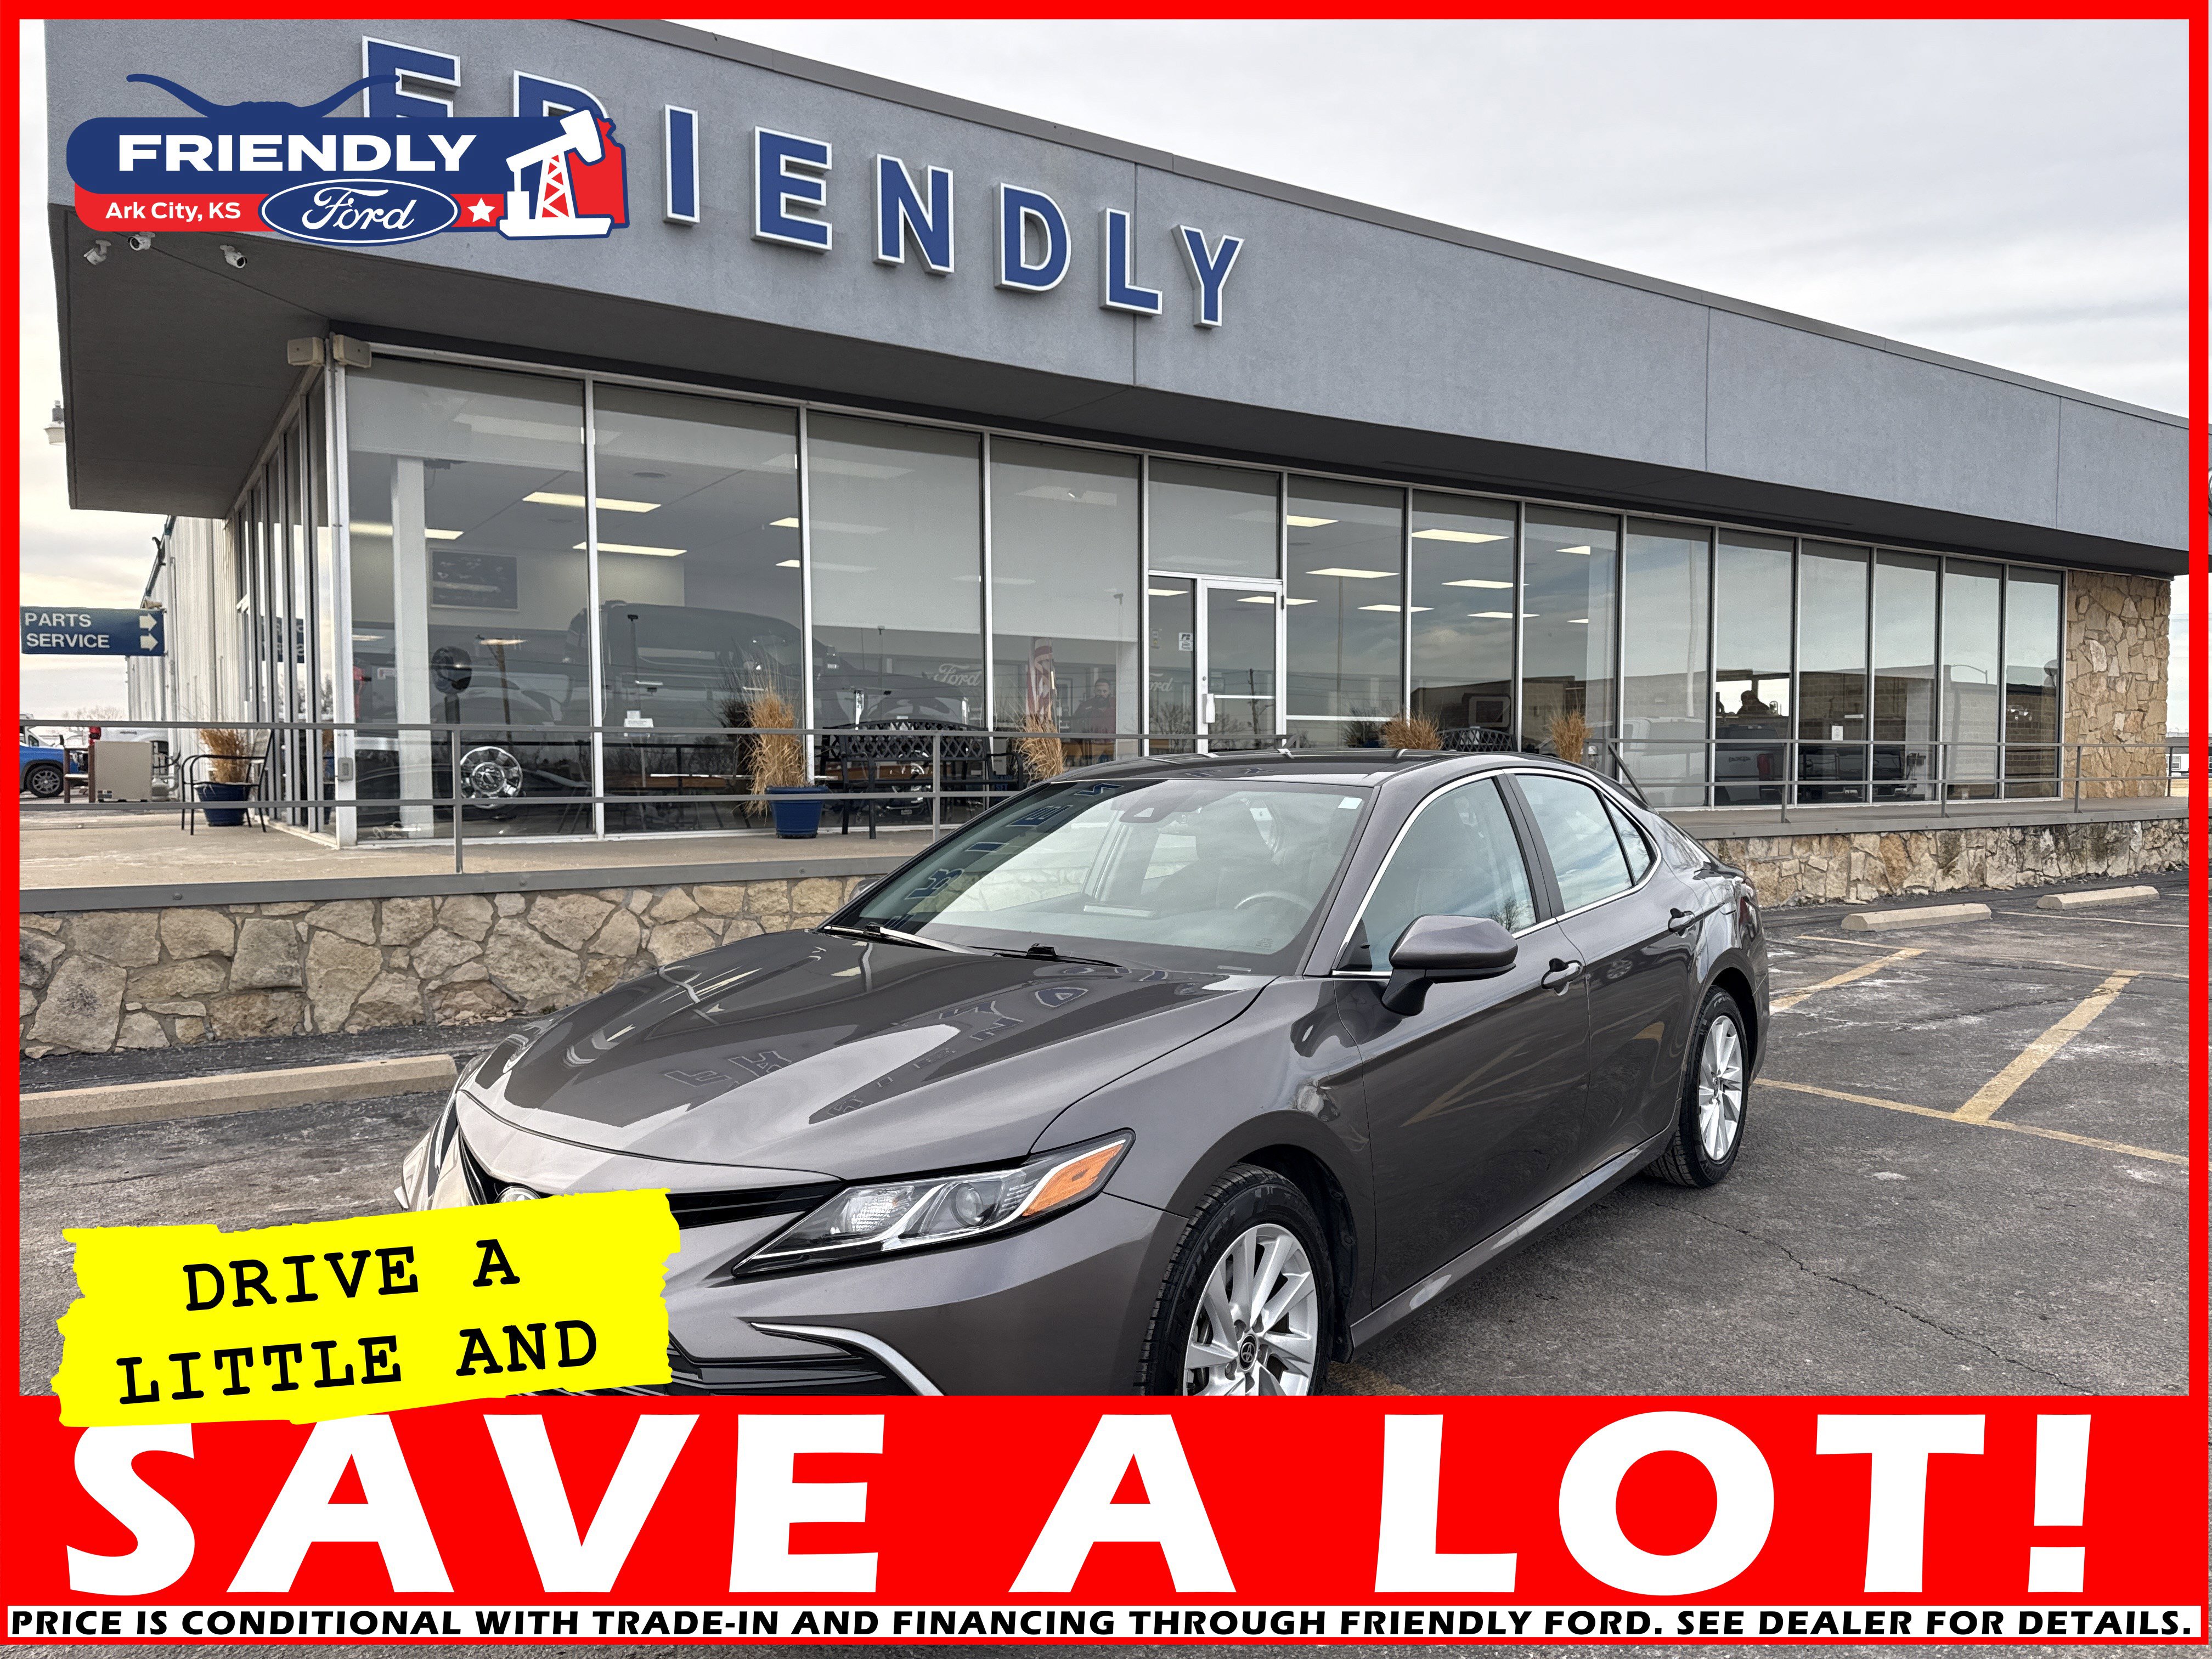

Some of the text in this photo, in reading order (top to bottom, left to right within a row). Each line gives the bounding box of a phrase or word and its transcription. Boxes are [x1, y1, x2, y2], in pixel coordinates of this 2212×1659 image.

[25, 612, 92, 627] PARTS
[26, 633, 110, 648] SERVICE
[934, 663, 982, 686] Ford
